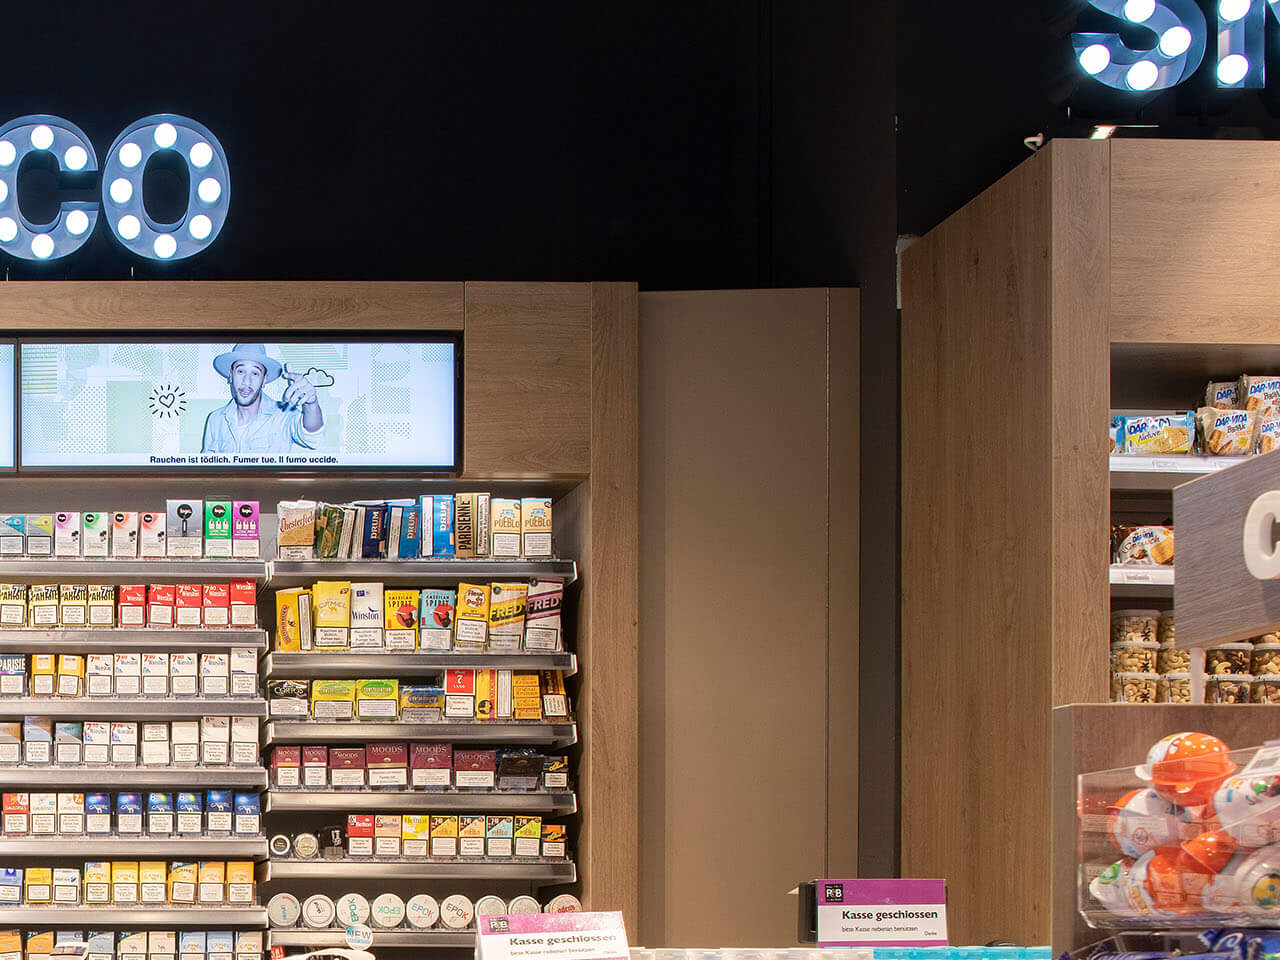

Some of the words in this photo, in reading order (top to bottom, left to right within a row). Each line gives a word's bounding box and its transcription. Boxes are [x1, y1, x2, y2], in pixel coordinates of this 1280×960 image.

[1215, 413, 1248, 428] DAR-VIDA
[371, 510, 379, 539] DRUM
[459, 500, 472, 551] PARISIENNE
[494, 519, 519, 529] PUEBLO
[490, 601, 525, 621] FRED
[528, 597, 561, 614] FRED
[351, 609, 380, 621] Winston
[371, 746, 403, 754] MOODS
[416, 746, 447, 754] MOODS
[411, 902, 434, 919] EPOK
[446, 902, 470, 920] EPOK
[842, 910, 873, 920] Kasse
[875, 909, 938, 922] geschlossen
[347, 929, 372, 940] NEW
[509, 936, 543, 946] Kasse
[547, 933, 617, 946] geschlossen
